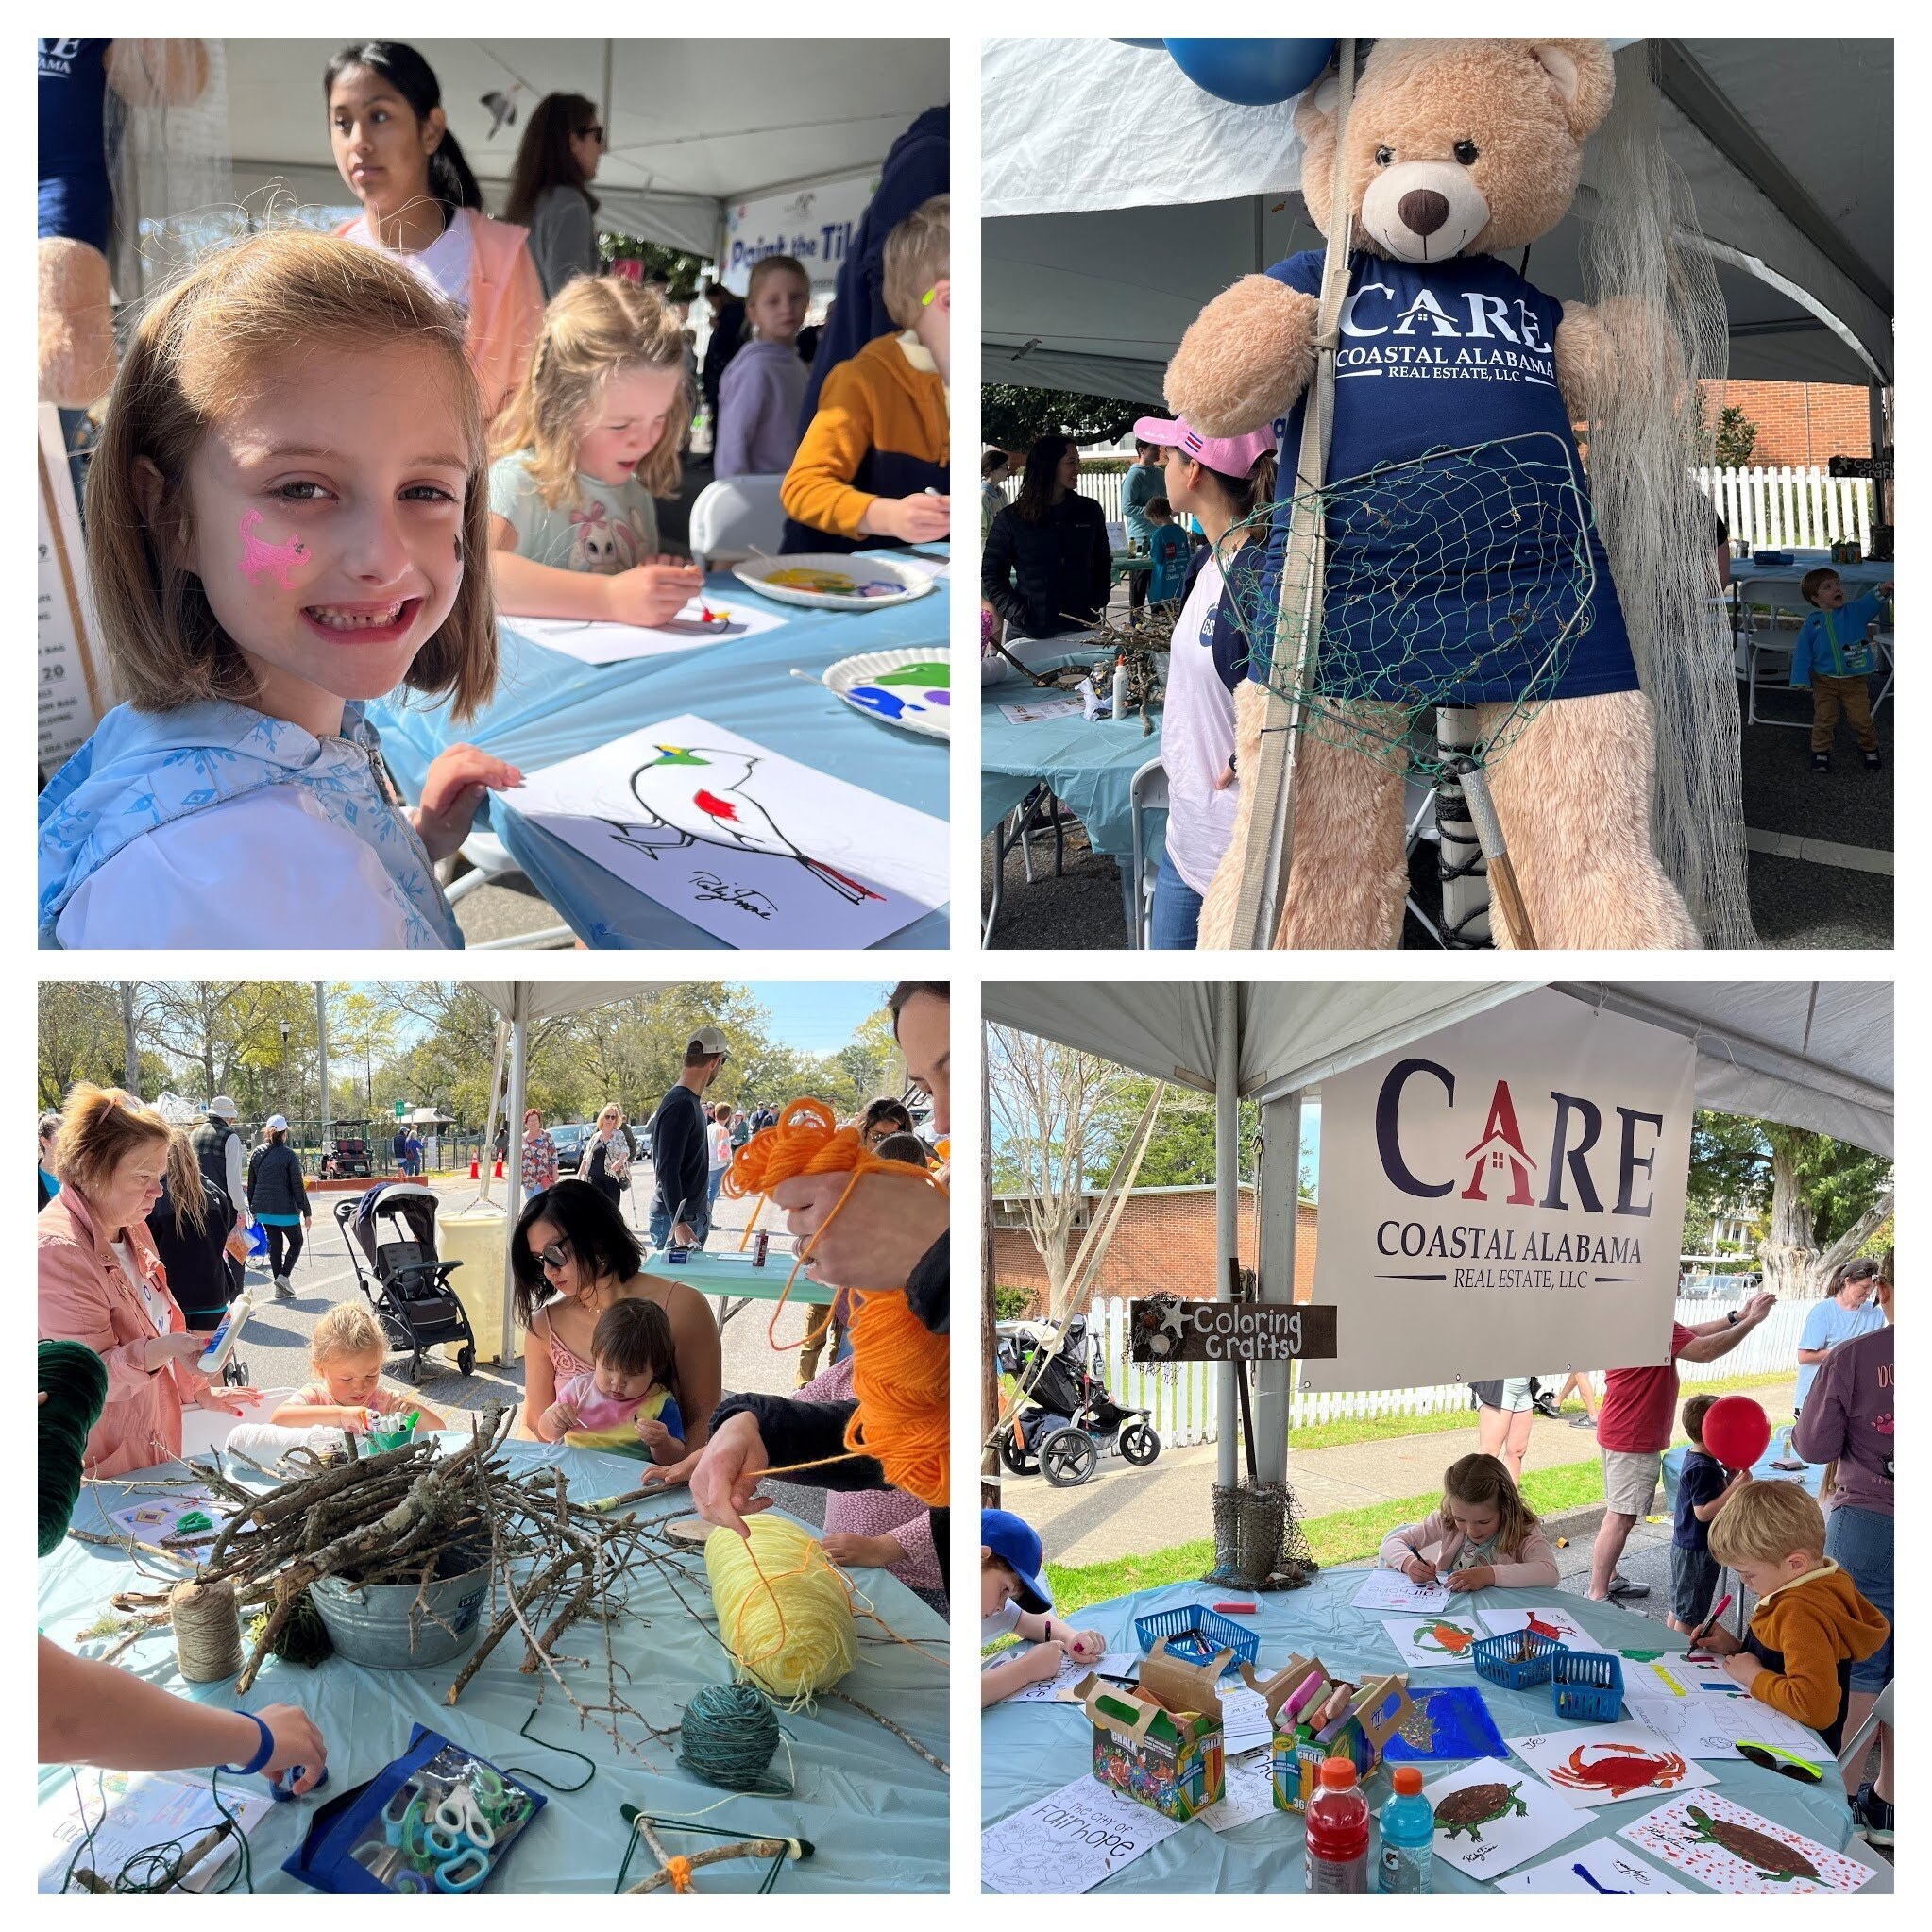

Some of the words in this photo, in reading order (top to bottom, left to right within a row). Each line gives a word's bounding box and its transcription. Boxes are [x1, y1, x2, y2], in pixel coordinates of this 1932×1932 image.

[821, 221, 853, 261] Til
[1339, 282, 1553, 354] CARE
[1336, 346, 1449, 368] COASTAL
[1455, 347, 1556, 380] ALABAMA
[1388, 366, 1430, 379] REAL
[1435, 366, 1493, 381] ESTATE,
[1495, 369, 1521, 382] LLC
[1375, 1058, 1664, 1218] CARE
[1377, 1220, 1517, 1260] COASTAL
[1522, 1230, 1643, 1264] ALABAMA
[1453, 1268, 1495, 1288] REAL
[1498, 1269, 1555, 1291] ESTATE,
[1559, 1271, 1588, 1289] LLC
[1194, 1305, 1302, 1355] Coloring
[1198, 1792, 1210, 1806] 36
[1293, 1797, 1306, 1810] 36
[1031, 1803, 1135, 1857] Fairhope
[1069, 1802, 1093, 1816] The
[1091, 1812, 1116, 1827] City
[1114, 1823, 1133, 1834] of
